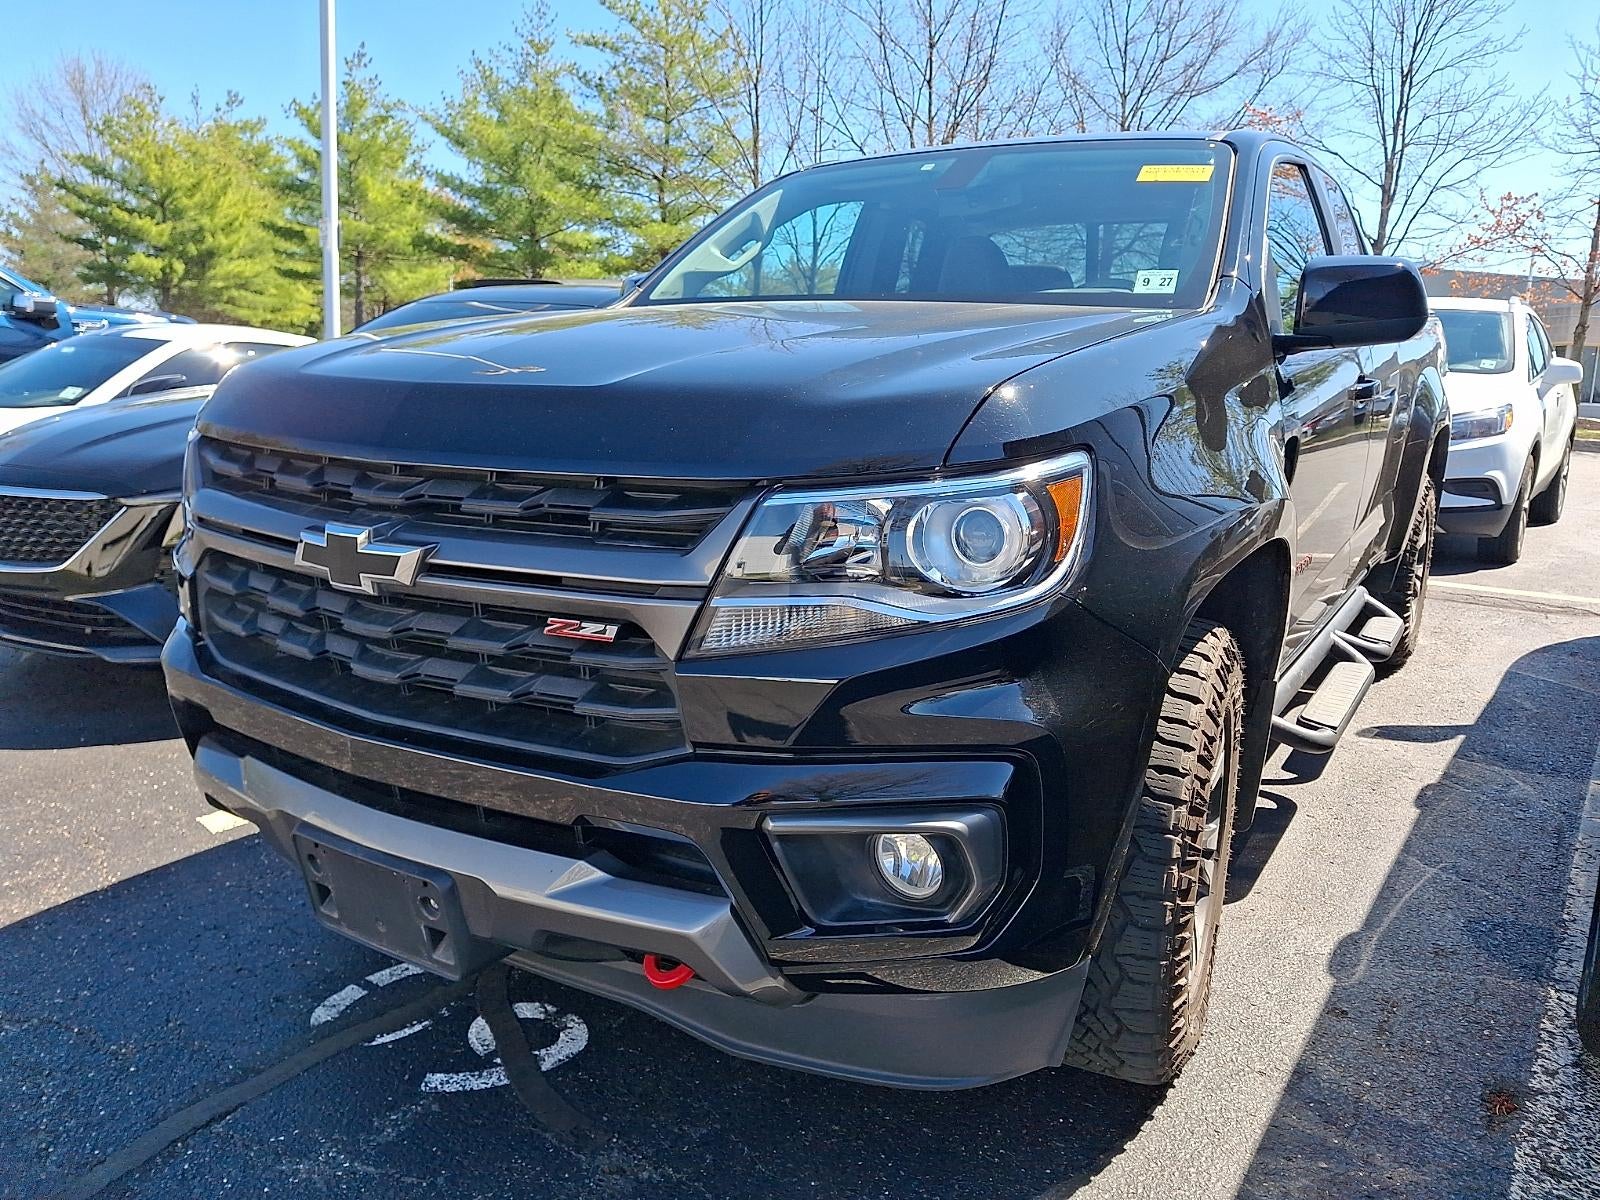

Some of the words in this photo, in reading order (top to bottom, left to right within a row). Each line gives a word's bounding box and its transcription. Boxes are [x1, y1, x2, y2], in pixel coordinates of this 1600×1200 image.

[1142, 277, 1151, 287] 9
[1158, 277, 1174, 287] 27
[543, 617, 619, 643] Z71
